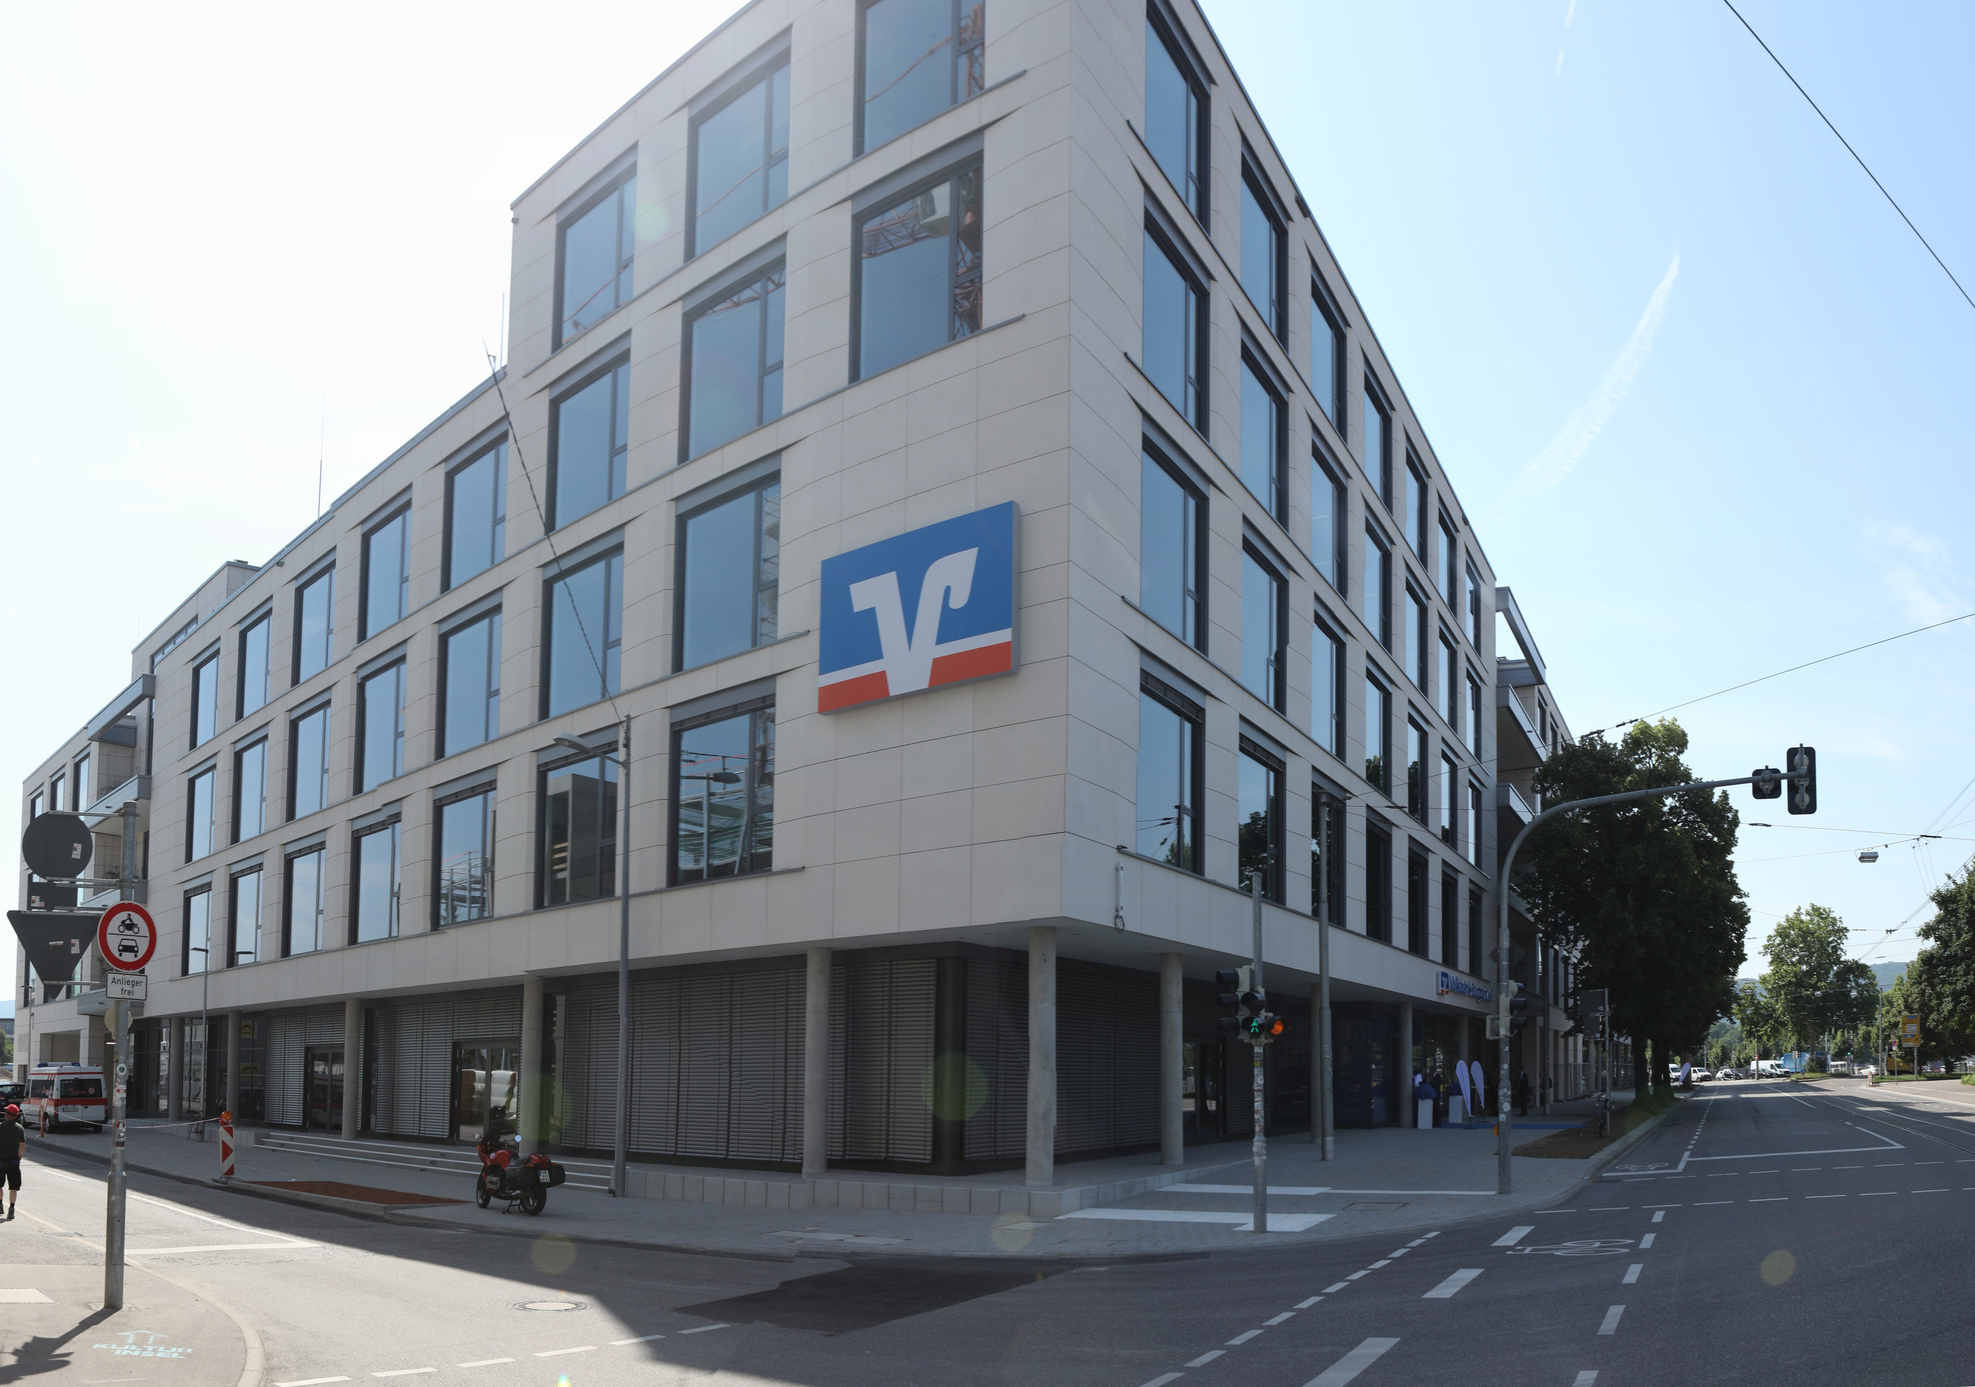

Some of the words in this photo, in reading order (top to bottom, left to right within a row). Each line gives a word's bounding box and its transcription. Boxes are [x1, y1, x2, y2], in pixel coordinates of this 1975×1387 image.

[111, 977, 143, 988] Anlieger
[120, 987, 134, 996] frei
[92, 1343, 193, 1354] KULTUR
[114, 1349, 186, 1359] INSEL
